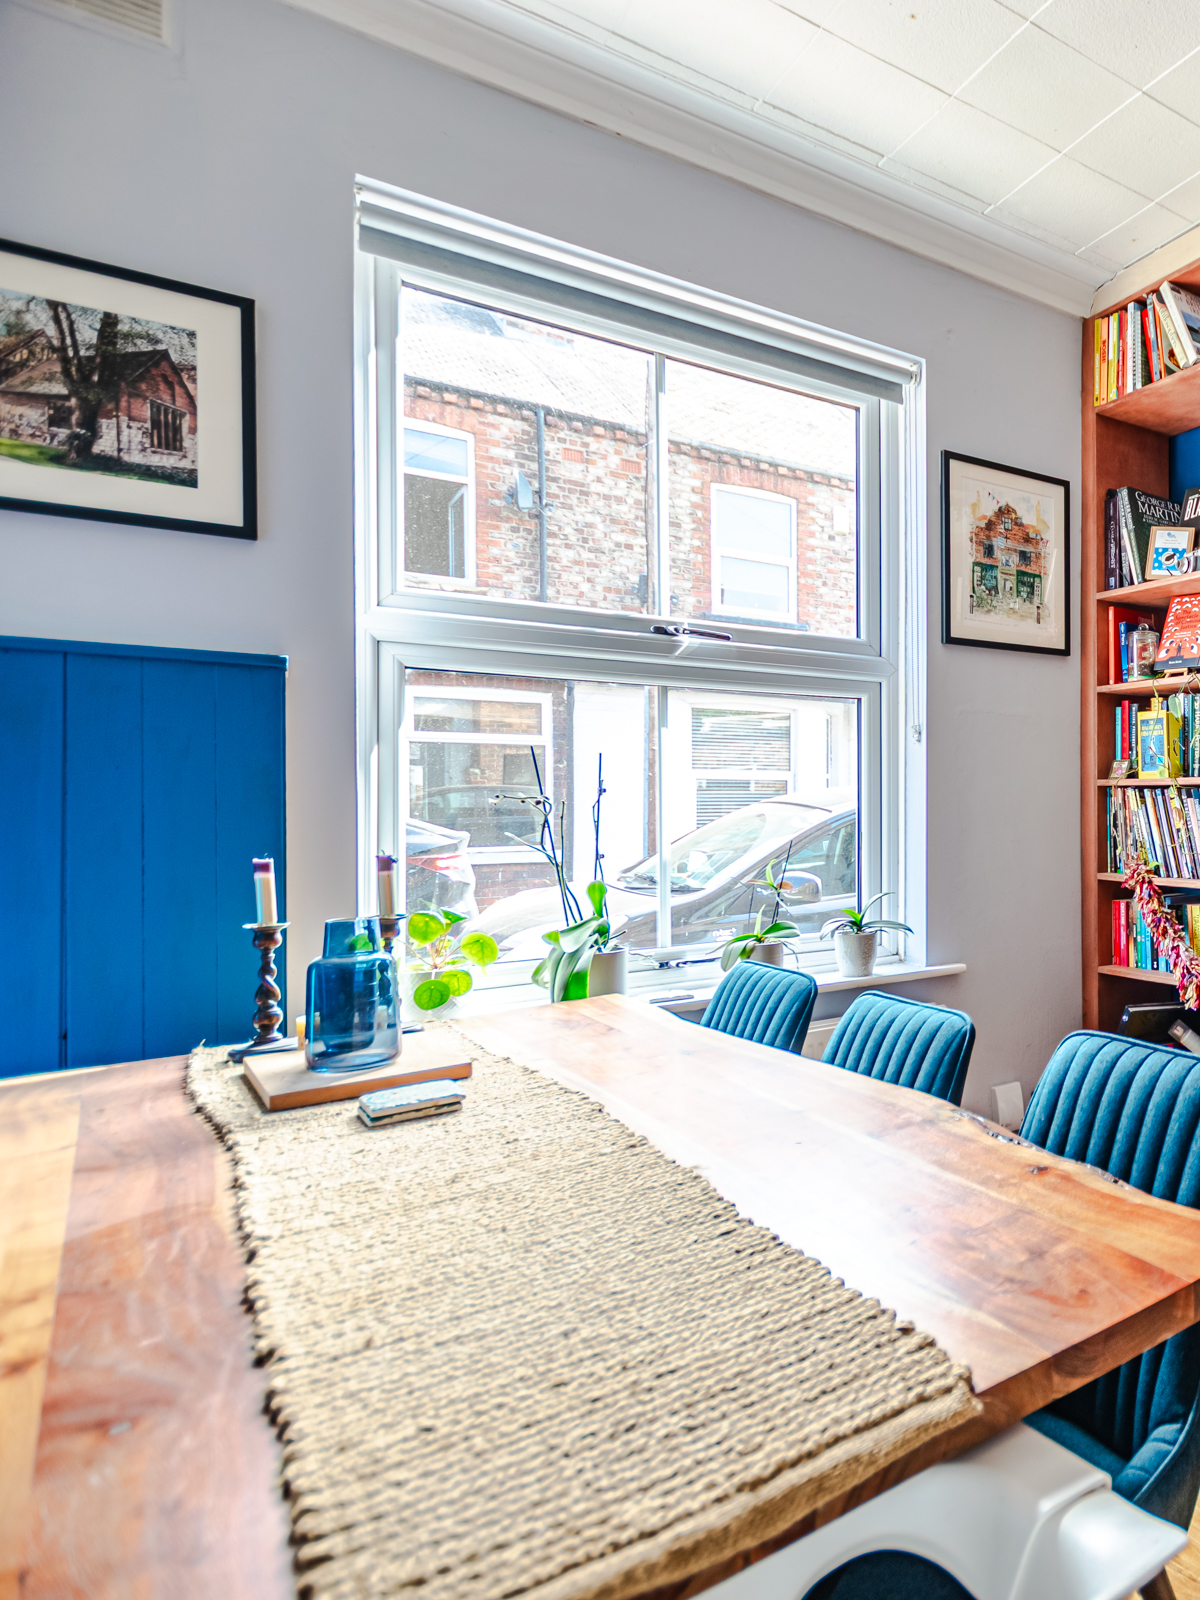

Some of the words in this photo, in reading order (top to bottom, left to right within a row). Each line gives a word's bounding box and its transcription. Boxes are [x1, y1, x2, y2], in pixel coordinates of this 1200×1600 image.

[1135, 491, 1166, 508] GEORGE
[1137, 500, 1182, 523] MARTIN
[1175, 613, 1199, 621] Spectacle
